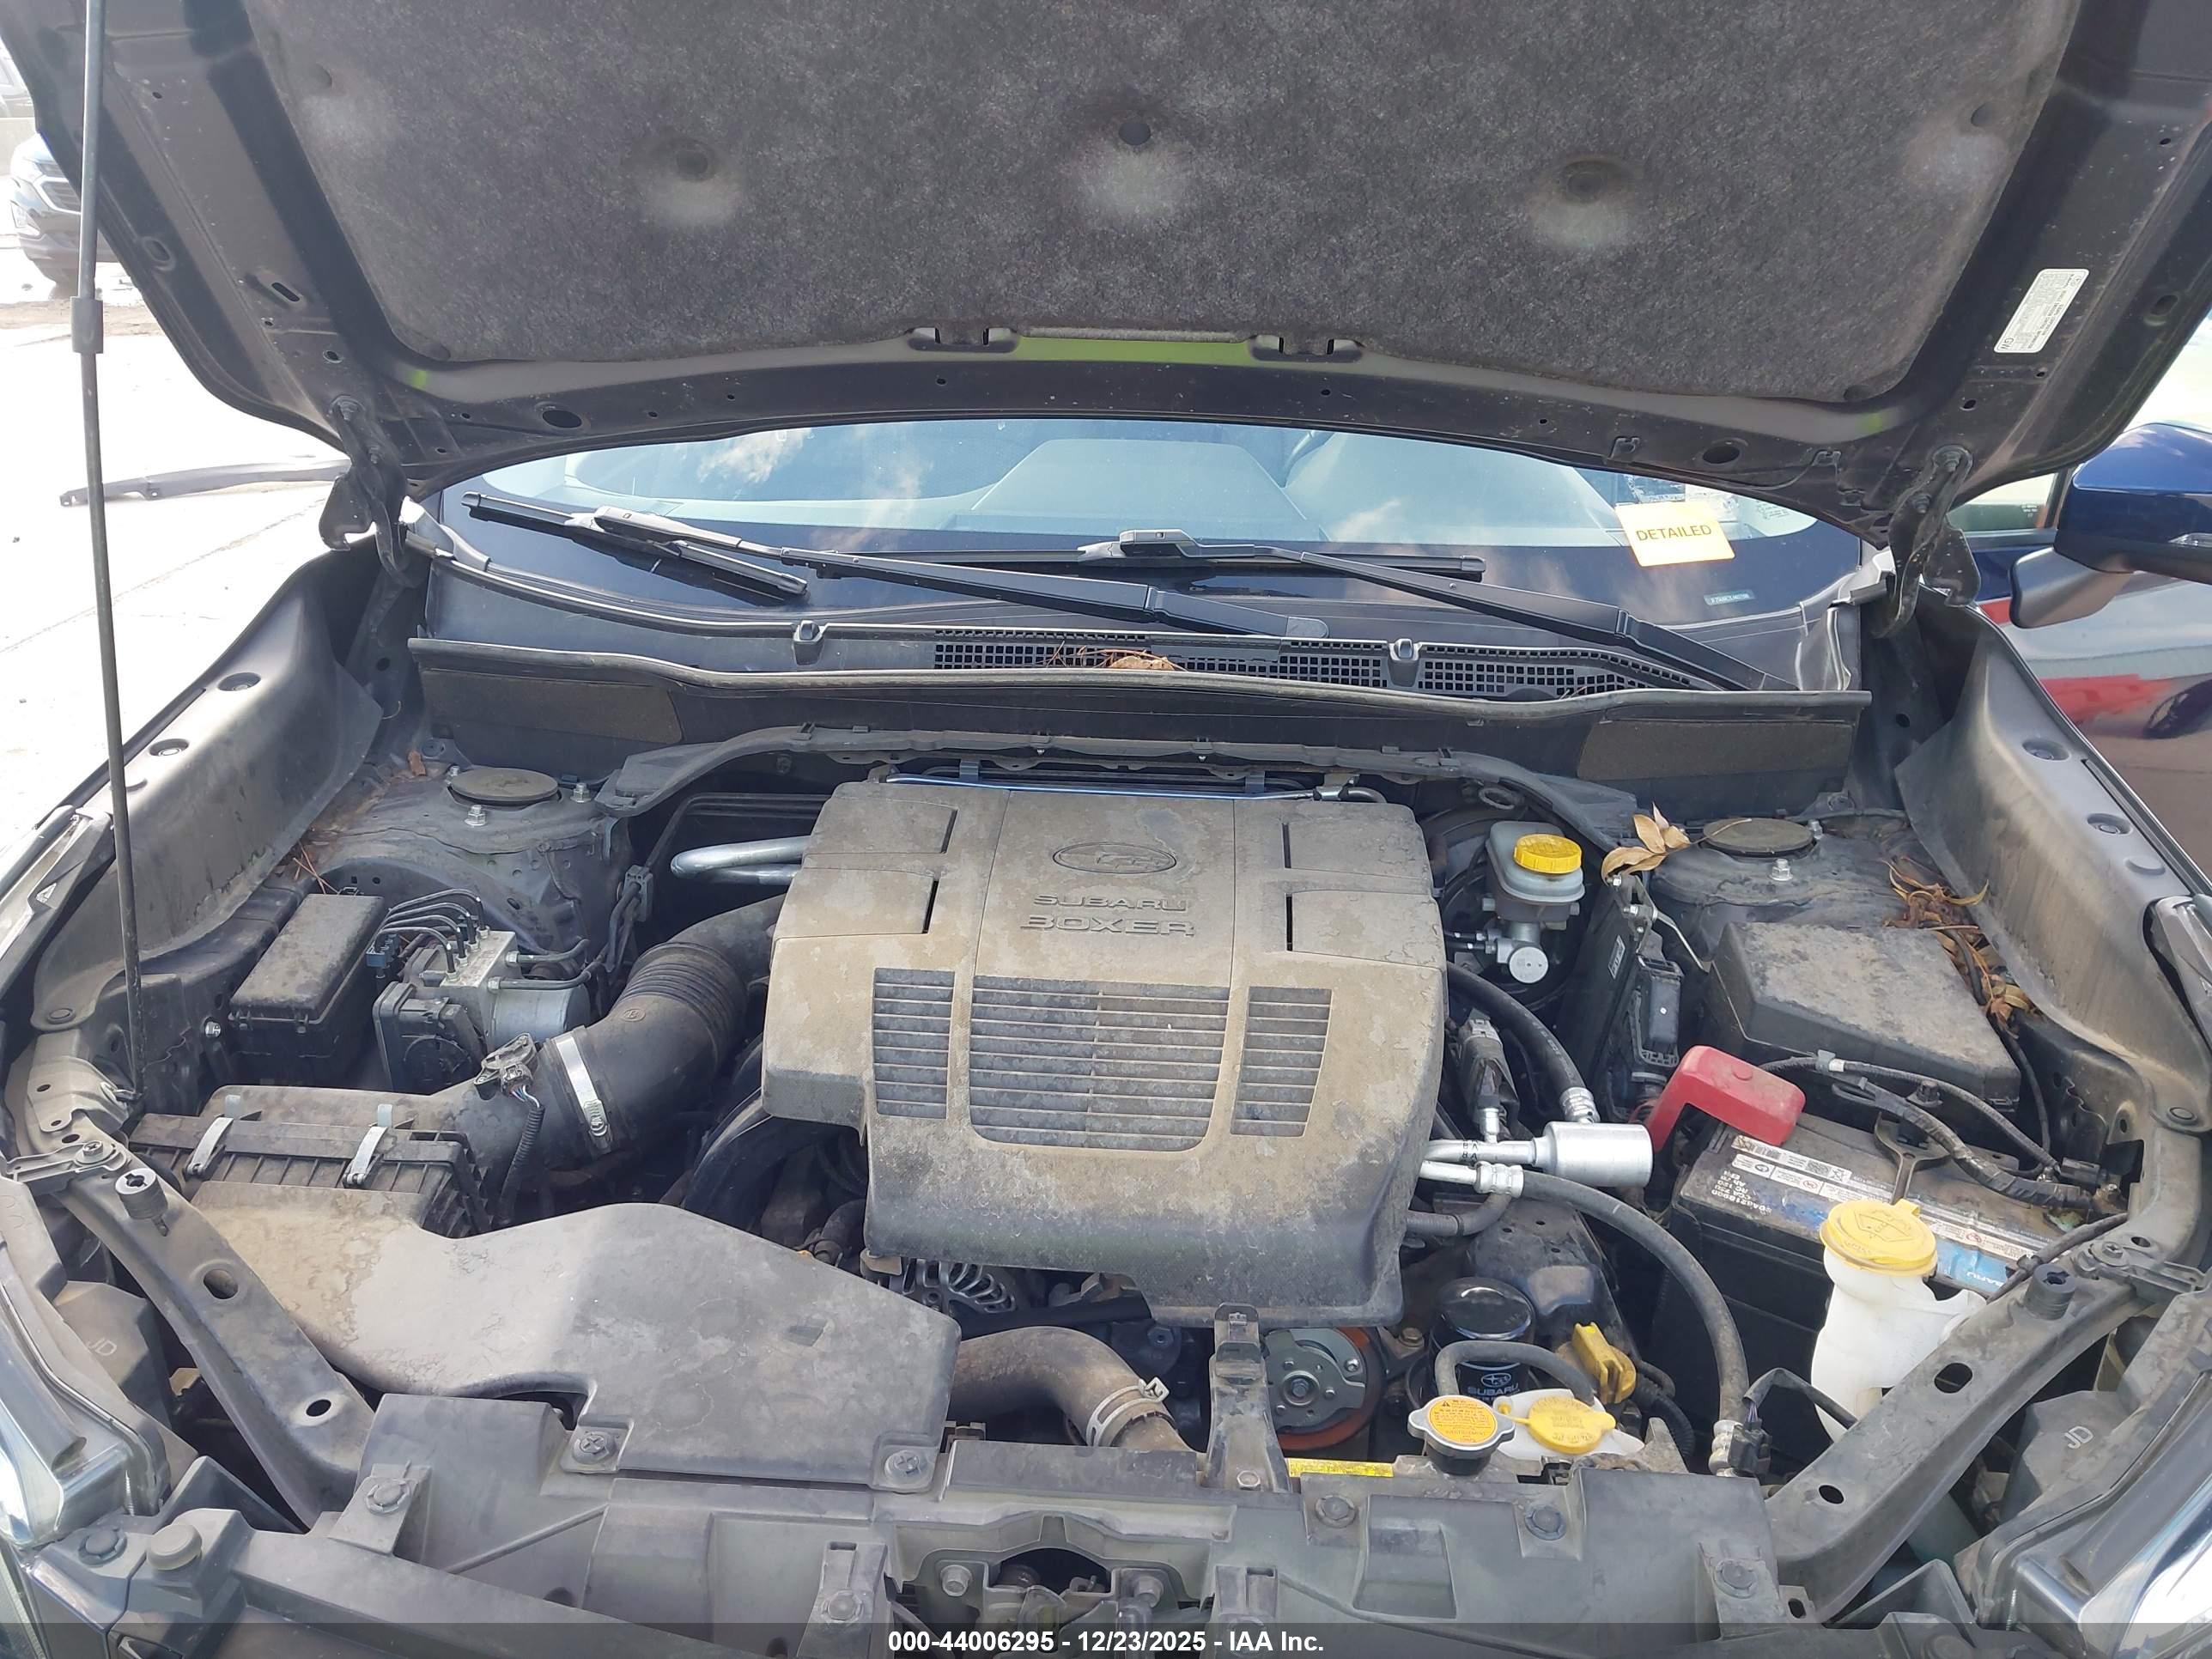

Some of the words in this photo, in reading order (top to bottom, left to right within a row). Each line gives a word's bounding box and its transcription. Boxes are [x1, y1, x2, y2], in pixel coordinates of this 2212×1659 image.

[1636, 524, 1712, 541] DETAILED
[1033, 894, 1189, 912] SUBARU
[1020, 914, 1194, 937] BOXER
[1468, 1382, 1519, 1396] SUBARU
[2064, 1425, 2094, 1449] JD
